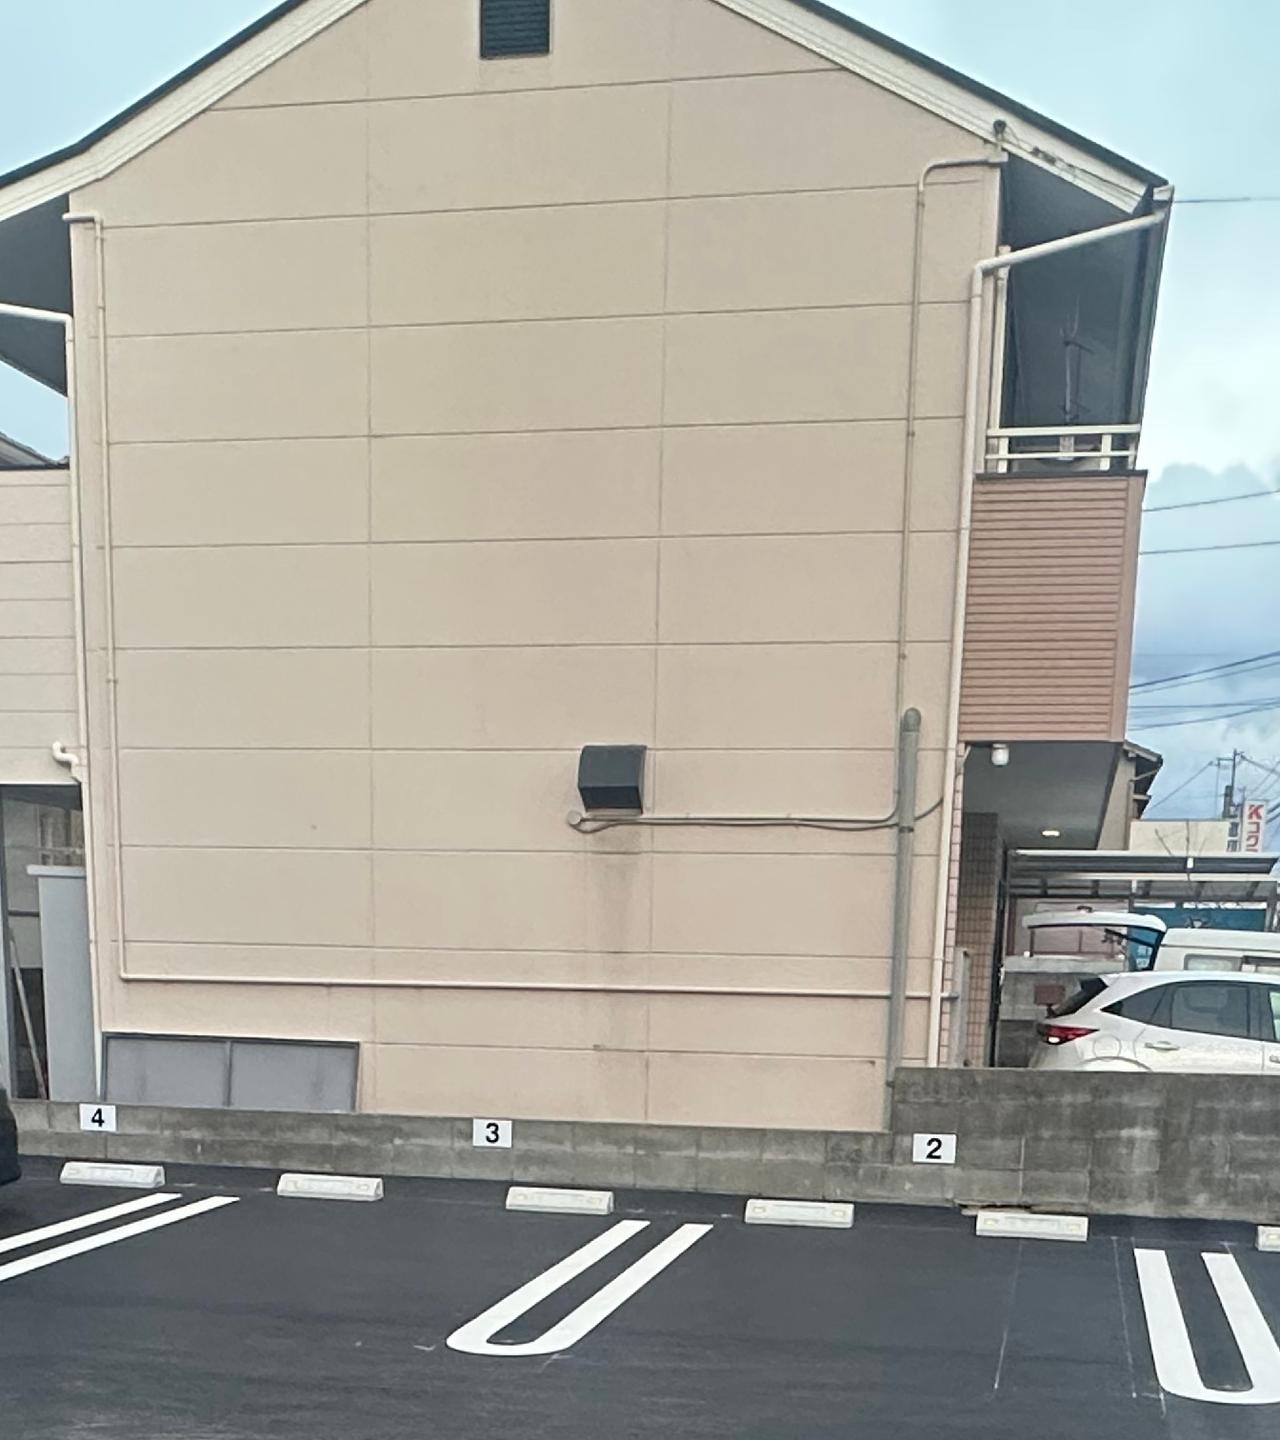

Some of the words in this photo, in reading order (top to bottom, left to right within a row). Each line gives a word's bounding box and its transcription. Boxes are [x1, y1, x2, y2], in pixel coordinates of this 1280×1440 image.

[91, 1108, 105, 1127] 4
[485, 1122, 500, 1144] 3
[926, 1138, 942, 1159] 2
